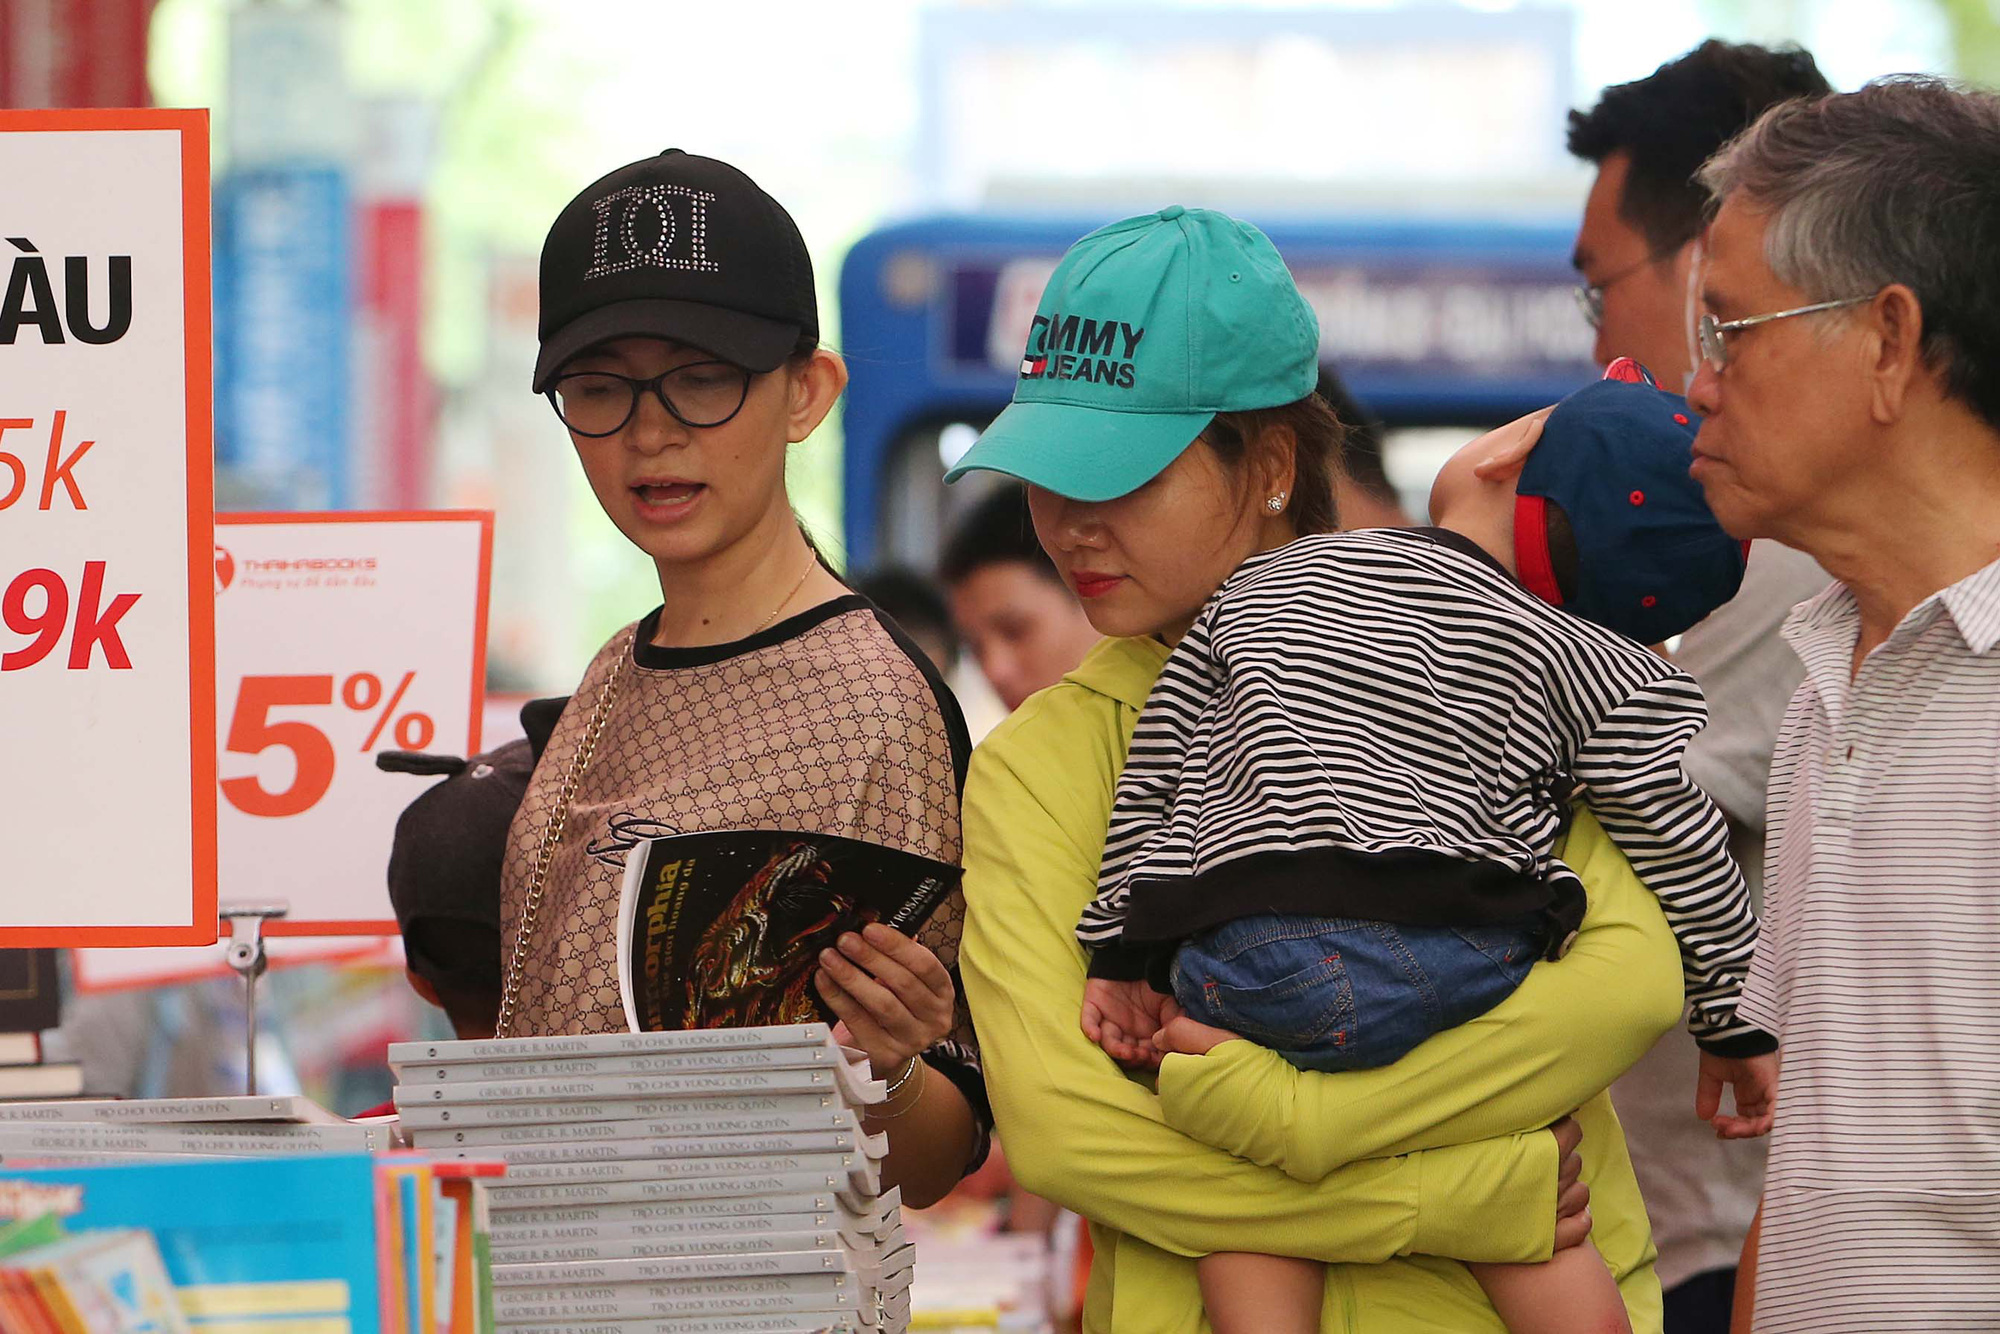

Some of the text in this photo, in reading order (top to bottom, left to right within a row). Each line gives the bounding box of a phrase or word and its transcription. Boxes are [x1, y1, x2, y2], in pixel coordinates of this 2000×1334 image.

[1047, 354, 1135, 389] JEANS
[2, 561, 141, 671] 9k
[893, 876, 937, 922] ROSANES
[473, 1044, 518, 1056] GEORGE
[544, 1041, 589, 1052] MARTIN
[482, 1065, 528, 1077] GEORGE
[554, 1062, 598, 1073] MARTIN
[479, 1086, 524, 1098] GEORGE
[550, 1083, 595, 1094] MARTIN
[487, 1108, 532, 1120] GEORGE
[558, 1105, 603, 1116] MARTIN
[501, 1129, 546, 1141] GEORGE
[572, 1126, 617, 1137] MARTIN
[503, 1149, 548, 1161] GEORGE
[574, 1146, 619, 1157] MARTIN
[508, 1168, 554, 1180] GEORGE
[580, 1165, 624, 1176] MARTIN
[493, 1189, 538, 1201] GEORGE
[564, 1186, 609, 1197] MARTIN
[556, 1211, 600, 1222] MARTIN
[554, 1227, 599, 1238] MARTIN
[556, 1248, 600, 1259] MARTIN
[562, 1267, 606, 1278] MARTIN
[500, 1292, 546, 1304] GEORGE
[572, 1289, 616, 1300] MARTIN
[503, 1306, 548, 1318] GEORGE
[574, 1303, 619, 1314] MARTIN
